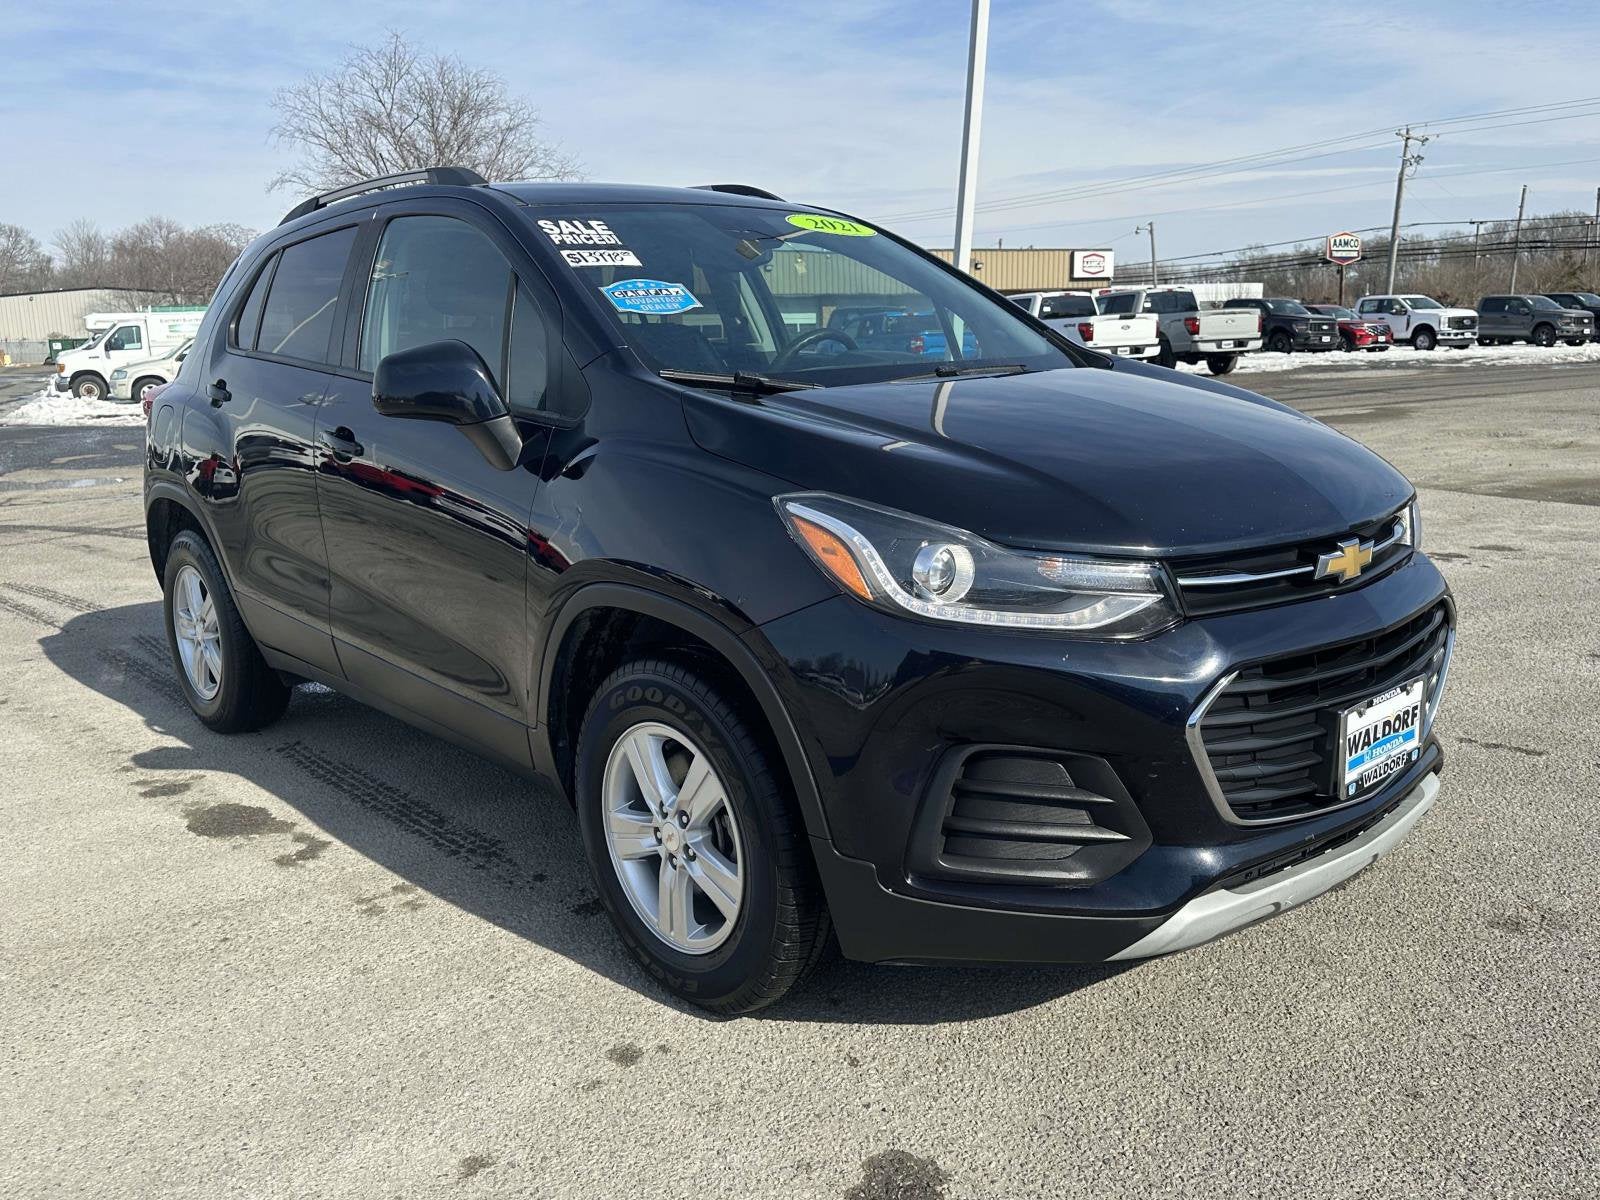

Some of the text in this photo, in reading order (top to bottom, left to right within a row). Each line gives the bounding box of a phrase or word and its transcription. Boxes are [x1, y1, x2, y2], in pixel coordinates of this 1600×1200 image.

[537, 220, 615, 235] SALE
[805, 218, 862, 232] 2021
[549, 234, 623, 245] PRICED!
[1332, 239, 1359, 248] AAMCO
[611, 288, 685, 298] CARFAX
[624, 296, 684, 305] ADVANTAGE
[640, 303, 680, 311] DEALER
[1372, 687, 1402, 706] HONDA
[1347, 704, 1419, 757] WALDORF
[1372, 736, 1404, 759] HONDA
[1363, 753, 1406, 786] WALDORF
